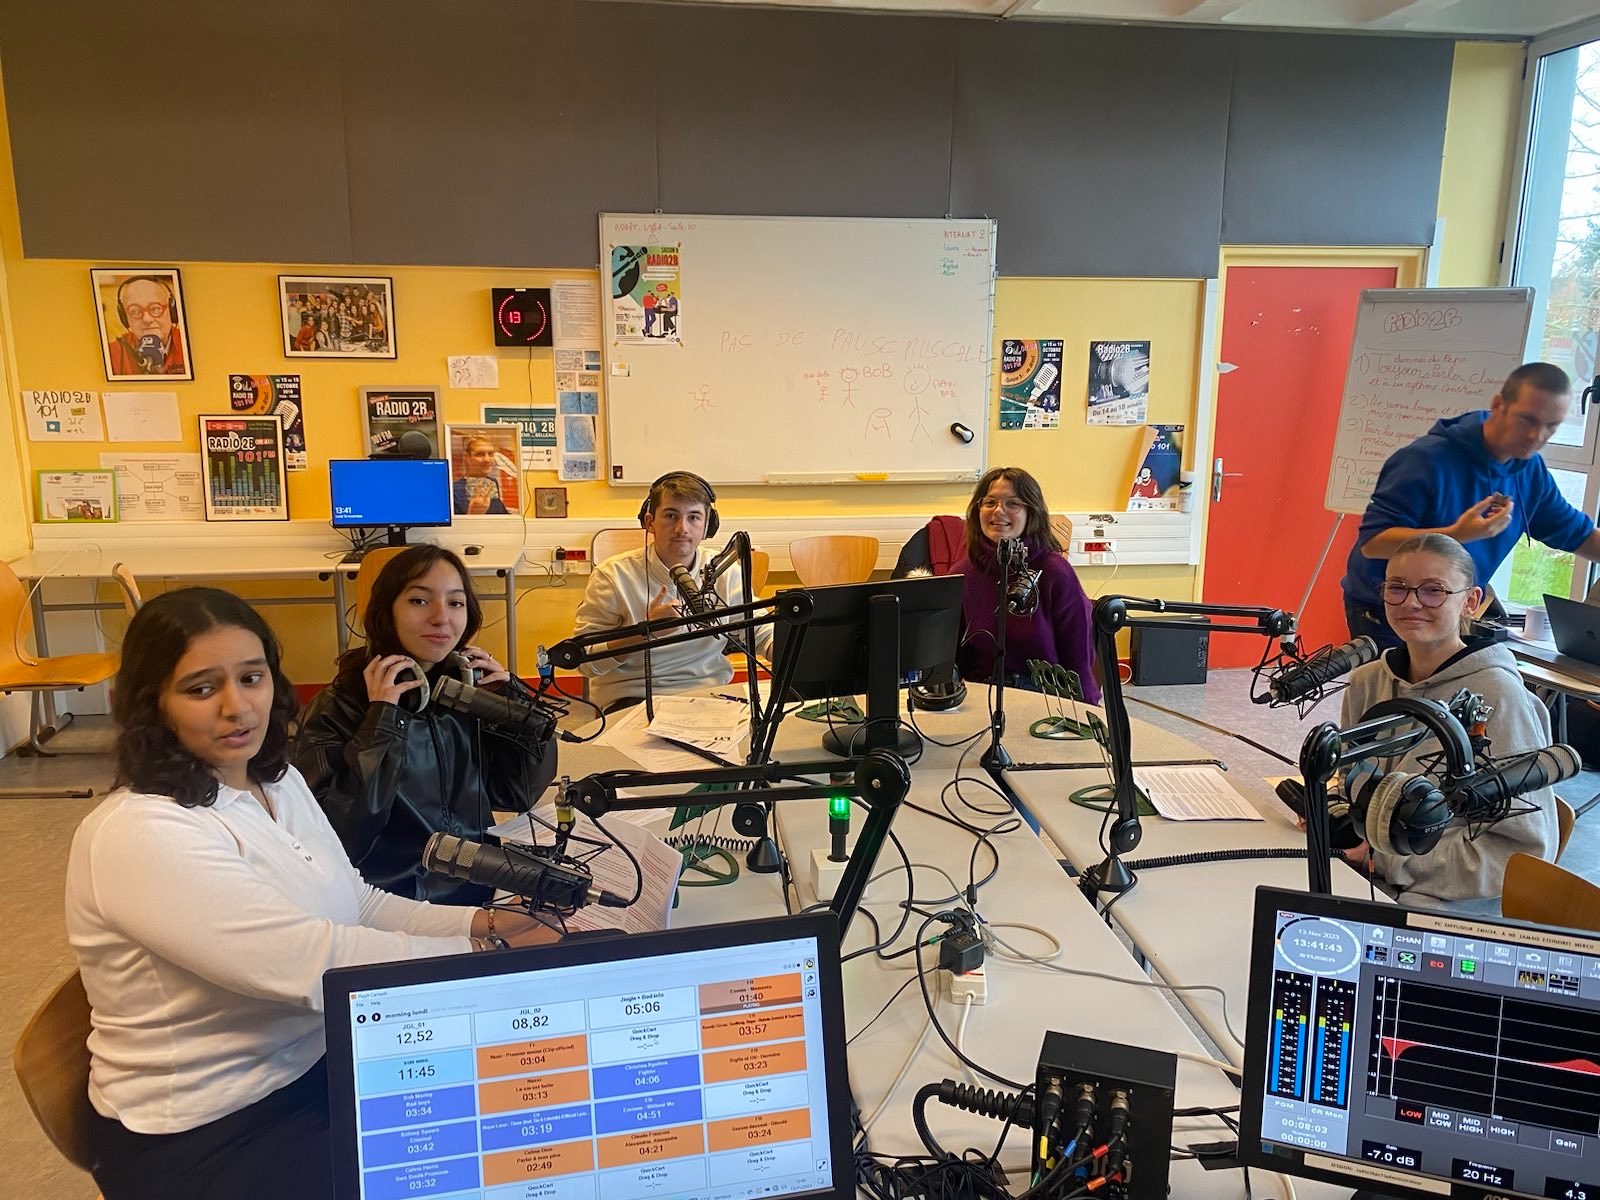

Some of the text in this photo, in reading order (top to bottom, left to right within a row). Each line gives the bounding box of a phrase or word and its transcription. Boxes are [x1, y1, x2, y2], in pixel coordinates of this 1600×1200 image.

[510, 312, 521, 324] 13
[720, 331, 752, 352] PAS
[777, 331, 806, 346] DE
[832, 328, 897, 356] PAUSE
[863, 362, 893, 378] BOB
[33, 390, 71, 404] RADIO
[376, 402, 410, 416] RADIO
[542, 422, 555, 432] 2B
[381, 430, 394, 440] FM
[208, 436, 240, 450] RADIO
[1158, 442, 1170, 450] 101
[238, 450, 262, 462] 101
[336, 506, 352, 514] 13:41
[1323, 932, 1340, 940] 2023
[1396, 936, 1422, 944] CHAN
[1294, 938, 1342, 952] 13:41:43
[1300, 952, 1336, 962] STUDER
[1430, 960, 1444, 968] EQ
[1518, 962, 1548, 970] Snapshot
[740, 992, 764, 1002] 01:40
[520, 1008, 542, 1016] JGL_02
[625, 1001, 660, 1016] 05:06
[386, 1010, 412, 1019] morning
[402, 1022, 426, 1030] JGL_01
[512, 1016, 549, 1030] 08,82
[632, 1027, 657, 1035] QuickCart
[738, 1024, 768, 1036] 03:57
[396, 1030, 434, 1044] 12,52
[520, 1056, 546, 1066] 03:04
[744, 1061, 768, 1071] 03:23
[398, 1066, 436, 1080] 11:45
[634, 1076, 660, 1086] 04:06
[522, 1091, 548, 1101] 03:13
[406, 1107, 432, 1118] 03:34
[637, 1110, 661, 1121] 04:51
[1325, 1110, 1343, 1119] Mon
[1400, 1108, 1422, 1118] LOW
[1432, 1111, 1450, 1120] MID
[1282, 1118, 1328, 1134] 00:08:03
[1430, 1118, 1452, 1128] LOW
[1462, 1117, 1481, 1126] MID
[522, 1123, 553, 1136] 03:19
[748, 1129, 772, 1139] 03:24
[1459, 1124, 1484, 1134] HIGH
[1490, 1126, 1515, 1136] HIGH
[1281, 1133, 1327, 1148] 00:00:00
[1556, 1139, 1577, 1149] Gain
[407, 1143, 434, 1154] 03:42
[639, 1145, 664, 1156] 04:21
[1367, 1150, 1415, 1166] -7.0 dB
[527, 1162, 552, 1172] 02:49
[641, 1166, 665, 1174] QuickCart
[1468, 1161, 1497, 1171] Frequency
[1463, 1168, 1502, 1185] 20 Hz
[409, 1179, 436, 1190] 03:32
[528, 1183, 554, 1191] QuickCart
[1565, 1190, 1586, 1200] 4.3
